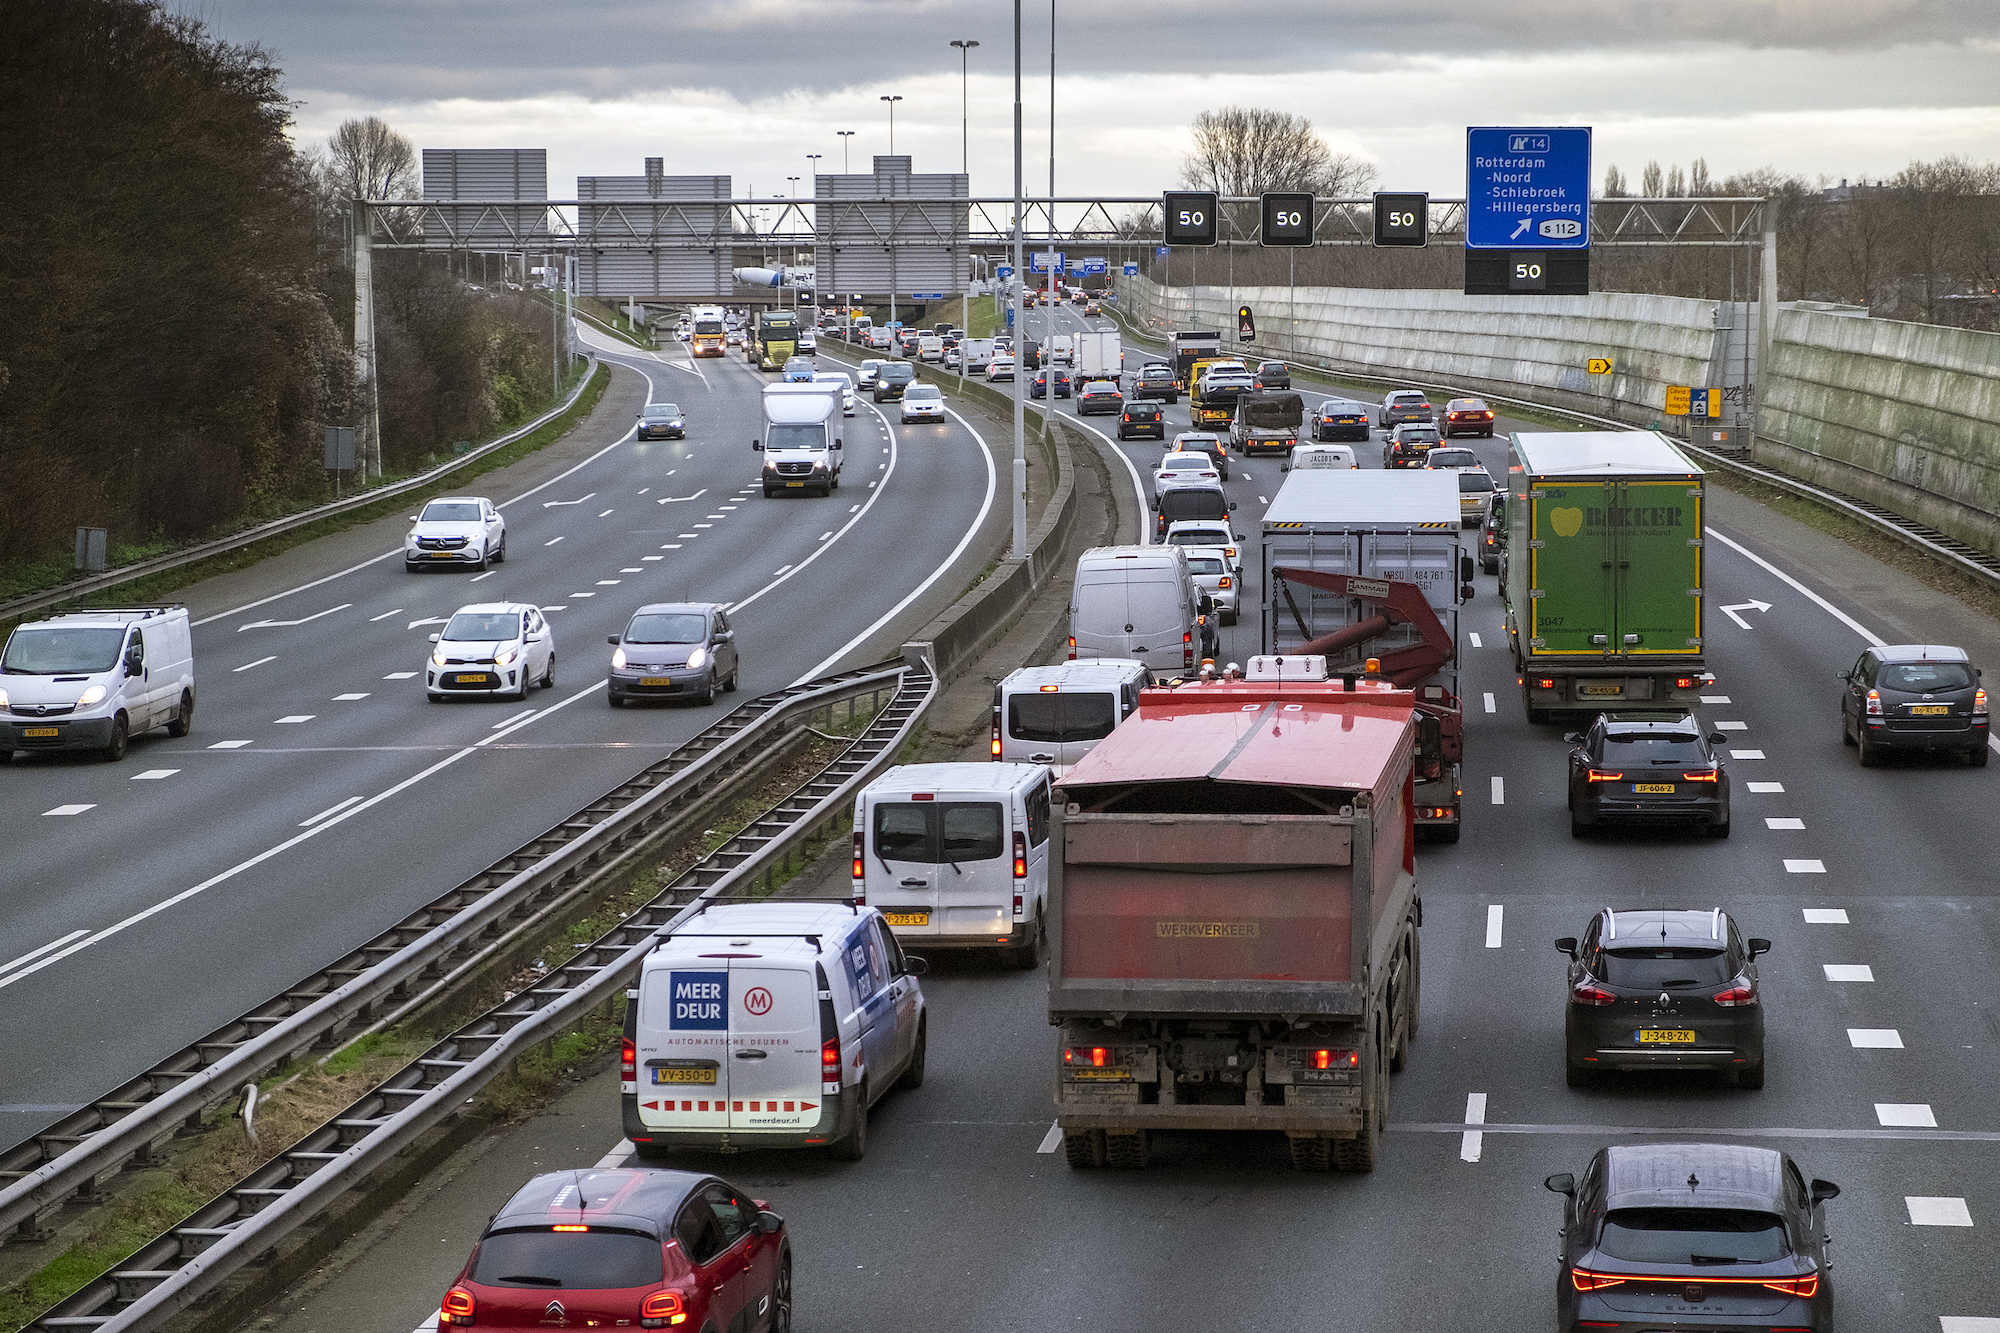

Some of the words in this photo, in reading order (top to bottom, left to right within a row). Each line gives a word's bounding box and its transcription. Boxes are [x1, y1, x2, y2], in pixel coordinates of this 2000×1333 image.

[1531, 138, 1546, 149] 14
[1475, 156, 1546, 168] Rotterdam
[1178, 210, 1204, 226] 50
[1276, 210, 1302, 226] 50
[1389, 211, 1415, 227] 50
[1555, 223, 1576, 234] 112
[1515, 264, 1542, 279] 50
[1593, 362, 1601, 371] A
[1310, 455, 1332, 463] JACOBS
[1586, 507, 1683, 527] BAKKER
[1383, 570, 1405, 580] MRSU
[1414, 570, 1428, 580] 484
[1430, 570, 1443, 580] 761
[1448, 571, 1454, 580] 7
[1538, 617, 1564, 626] 3047
[1638, 784, 1673, 792] JF-606-Z
[1159, 924, 1256, 936] WERKVERKEER
[675, 982, 722, 999] MEER
[750, 992, 767, 1009] M
[675, 1003, 721, 1020] DEUR
[1643, 1031, 1690, 1041] J-348-ZK
[667, 1038, 745, 1046] AUTOMATISCHE
[750, 1038, 790, 1046] DEUREN
[660, 1070, 712, 1081] VV-350-D
[1303, 1071, 1349, 1081] MAN
[749, 1117, 800, 1125] meerdeur.nl
